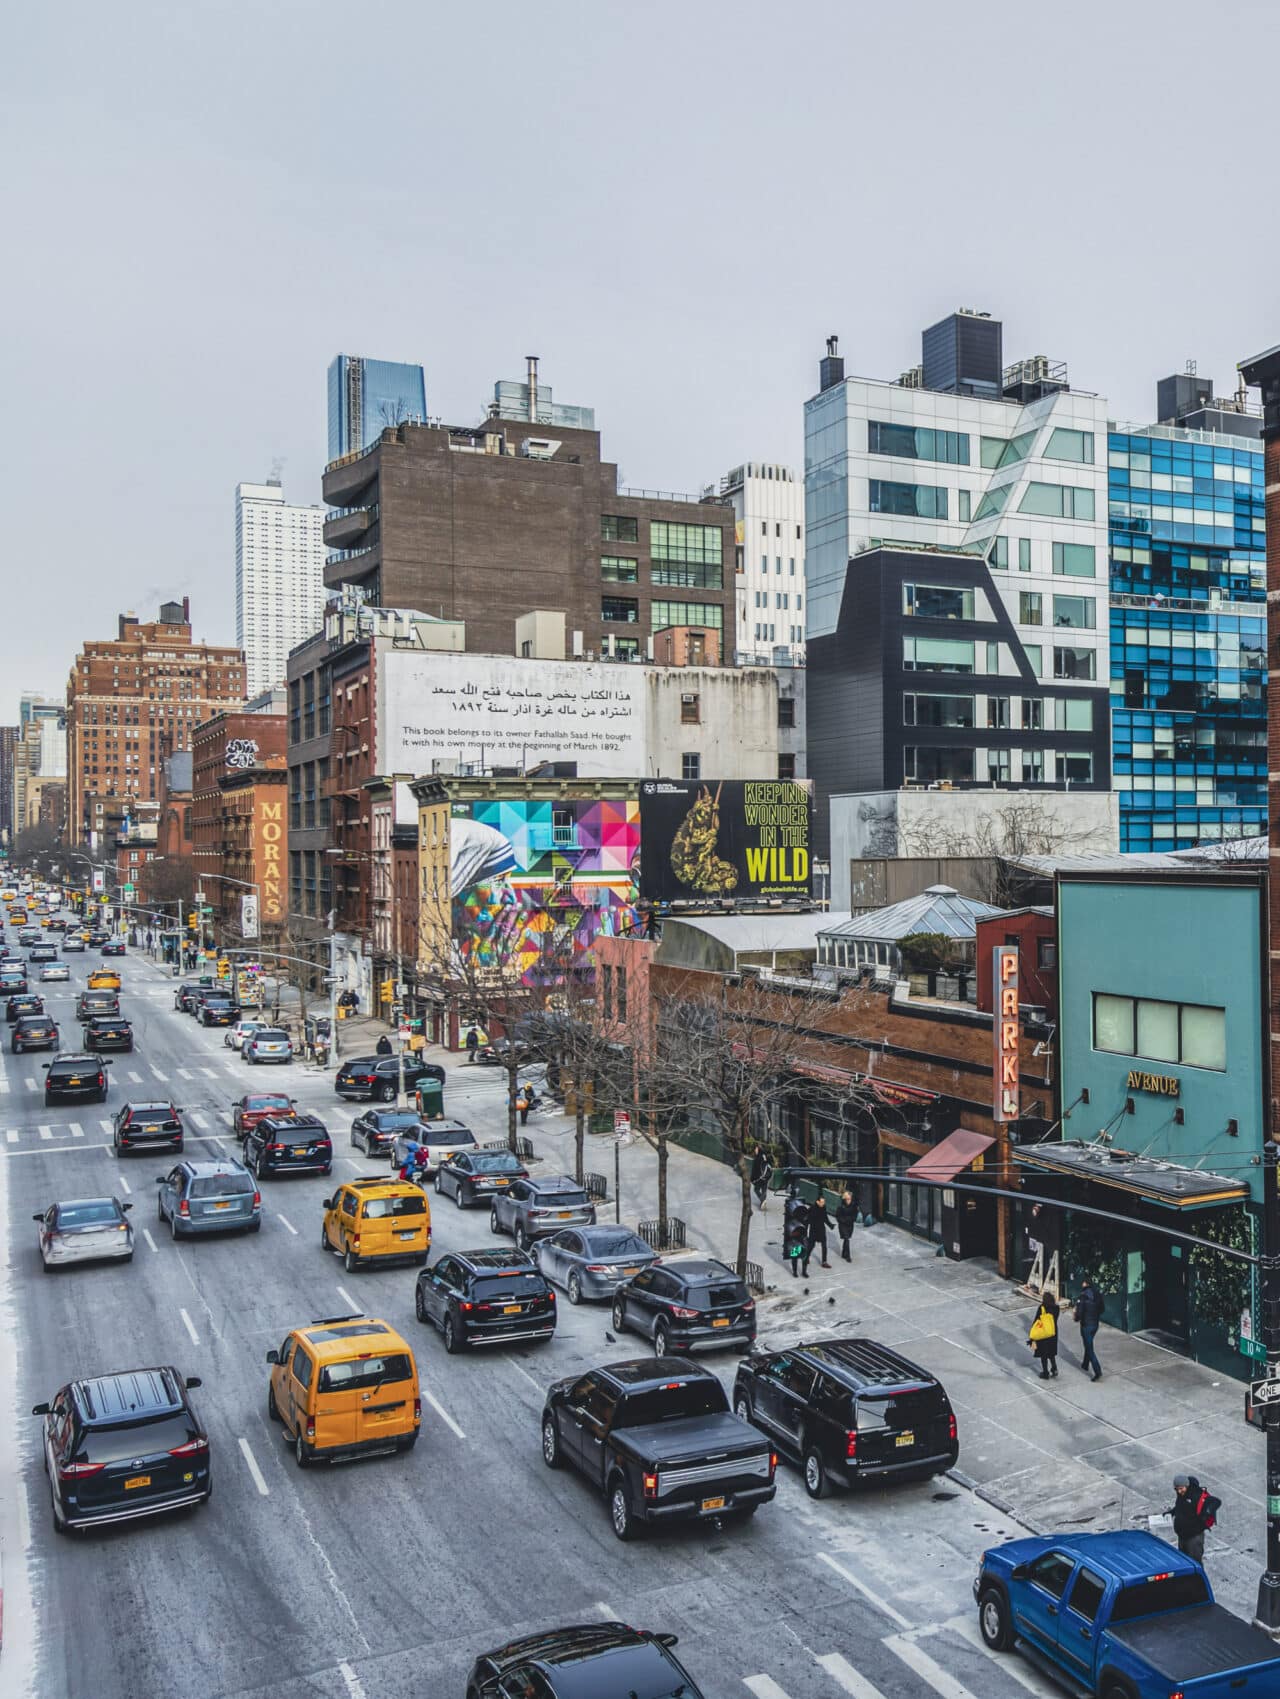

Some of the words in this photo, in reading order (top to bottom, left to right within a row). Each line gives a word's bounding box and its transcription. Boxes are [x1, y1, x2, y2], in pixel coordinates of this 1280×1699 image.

[460, 682, 478, 695] الله
[482, 686, 501, 700] فتح
[615, 690, 631, 700] هذا
[547, 690, 577, 702] يخص
[581, 689, 612, 703] الكتاب
[487, 702, 508, 713] سنة
[581, 708, 596, 718] من
[402, 726, 421, 735] This
[424, 727, 445, 736] book
[448, 728, 480, 738] belongs
[494, 729, 503, 737] its
[534, 730, 569, 738] Fathallah
[592, 731, 603, 739] He
[605, 732, 632, 742] bought
[402, 738, 409, 746] it
[411, 739, 430, 747] with
[432, 739, 444, 747] his
[468, 741, 495, 750] money
[508, 740, 521, 749] the
[523, 741, 561, 752] beginning
[563, 742, 572, 750] of
[573, 742, 598, 750] March
[744, 782, 808, 804] KEEPING
[744, 805, 808, 826] WONDER
[760, 826, 776, 847] IN
[781, 826, 808, 847] THE
[746, 848, 809, 882] WILD
[1001, 954, 1018, 1083] PARK
[1126, 1071, 1178, 1095] AVENUE
[1247, 1341, 1254, 1355] 10
[1261, 1386, 1276, 1397] ONE
